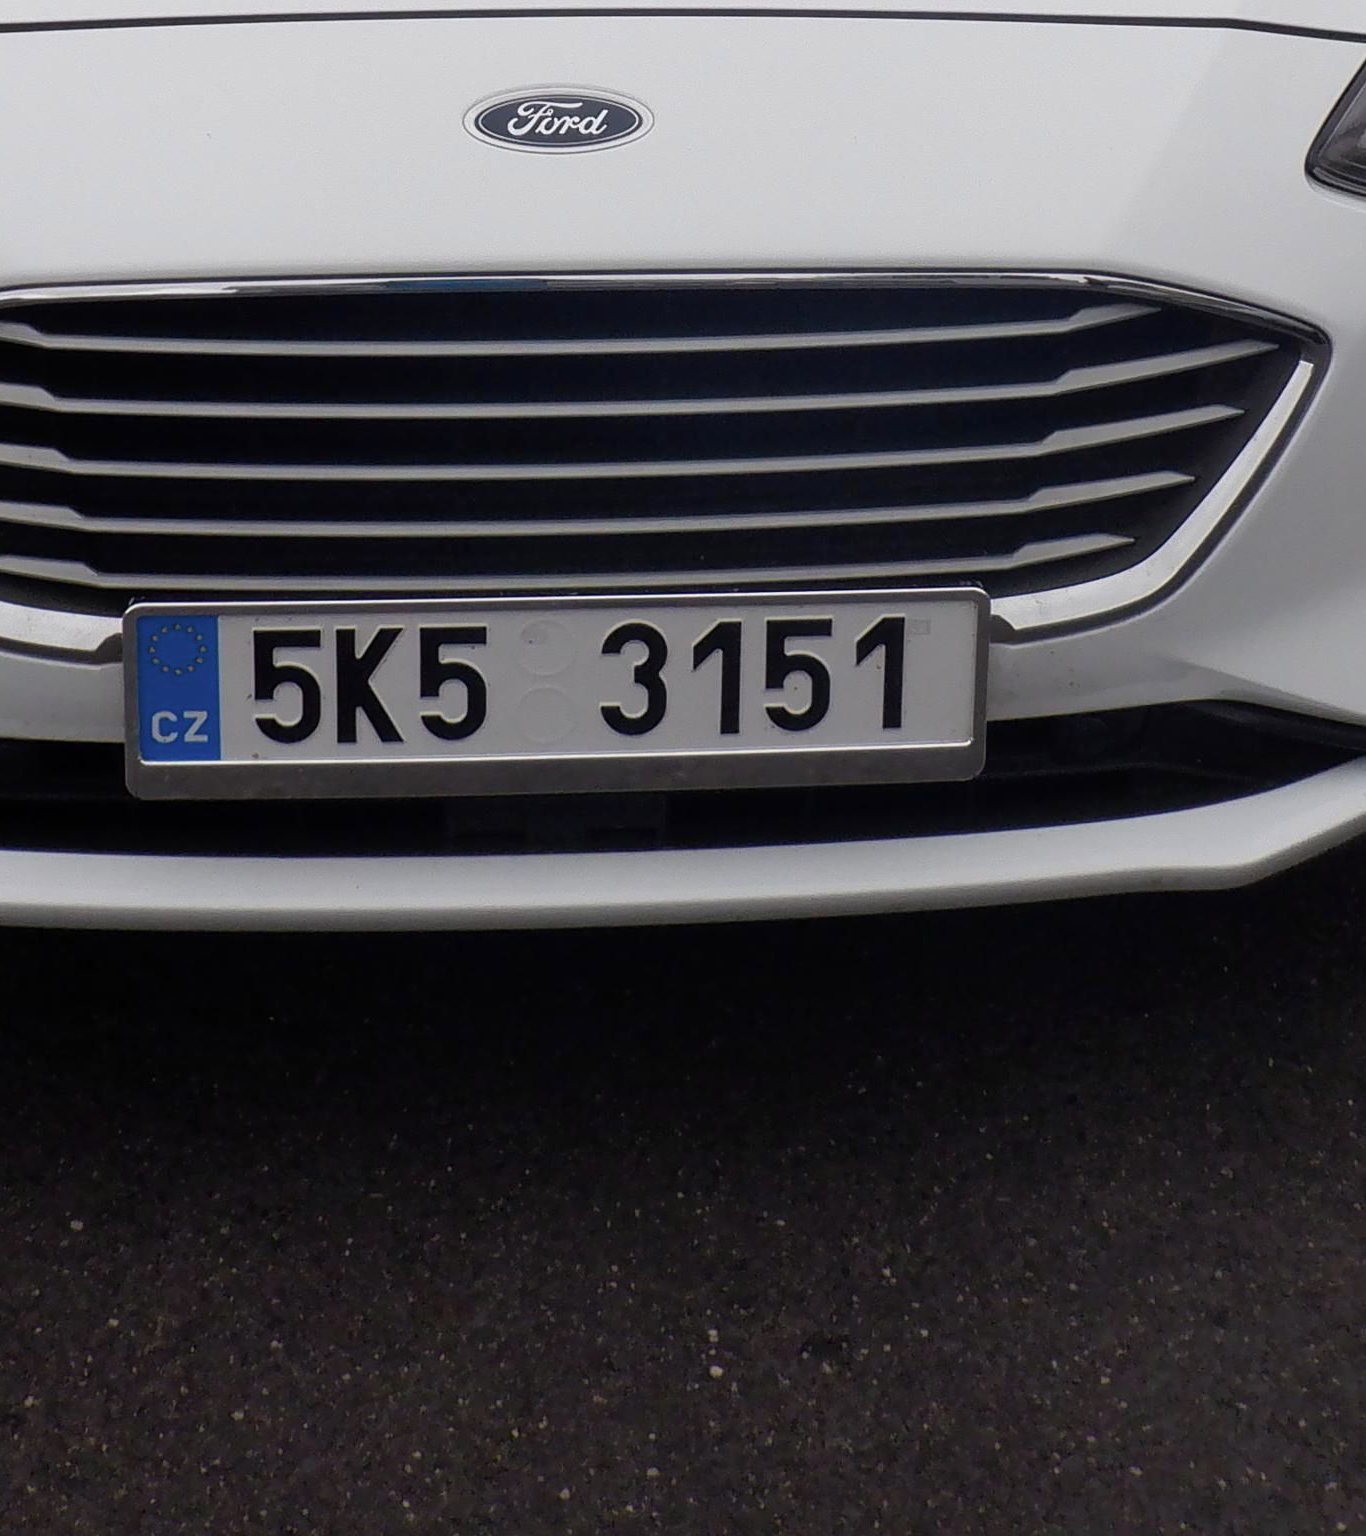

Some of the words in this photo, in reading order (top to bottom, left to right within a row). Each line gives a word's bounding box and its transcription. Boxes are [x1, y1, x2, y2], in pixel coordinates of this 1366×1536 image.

[507, 101, 608, 135] Ford
[151, 710, 208, 743] CZ
[252, 625, 488, 745] 5K5
[600, 614, 906, 736] 3151
